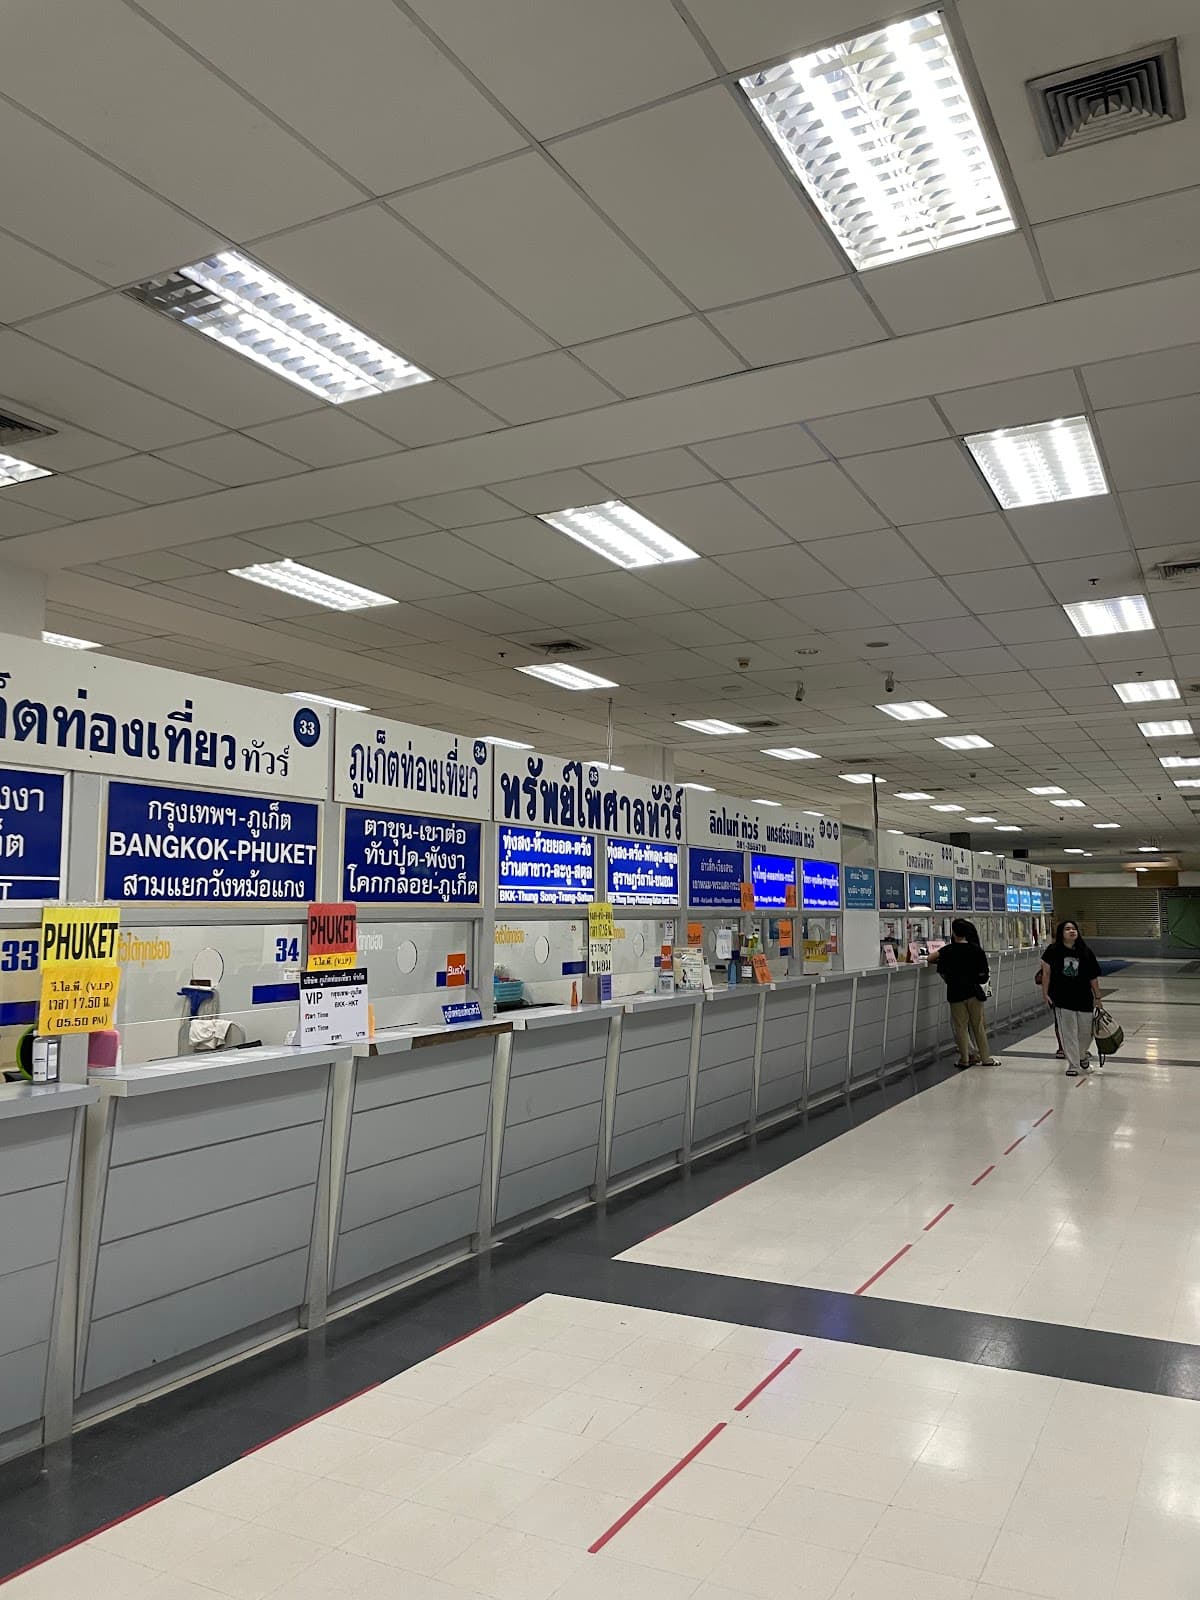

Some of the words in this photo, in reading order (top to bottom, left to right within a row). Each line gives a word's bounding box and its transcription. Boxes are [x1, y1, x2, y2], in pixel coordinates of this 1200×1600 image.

[299, 719, 315, 736] 33
[241, 740, 290, 777] ทัวร์
[349, 729, 478, 800] ภูเก็ตท่องเที่ยว
[474, 745, 485, 759] 34
[589, 770, 598, 782] 35
[148, 801, 291, 838] กรุงเทพฯ-ภูเก็ต
[364, 819, 466, 847] ตาขุน-เขาต่อ
[108, 831, 317, 866] BANGKOK-PHUKET
[364, 840, 465, 875] ทับปุด-พังงา
[123, 869, 305, 899] สามแยกวังหม้อแกง
[346, 864, 478, 902] โคกกลอย-ภูเก็ต
[499, 890, 539, 905] BKK-Thung
[43, 922, 119, 960] PHUKET
[310, 915, 356, 945] PHUKET
[1, 940, 38, 972] 33
[275, 937, 299, 962] 34
[48, 999, 69, 1011] เวลา
[73, 996, 101, 1009] 17.50
[305, 991, 323, 1005] VIP
[56, 1017, 89, 1028] 05.50
